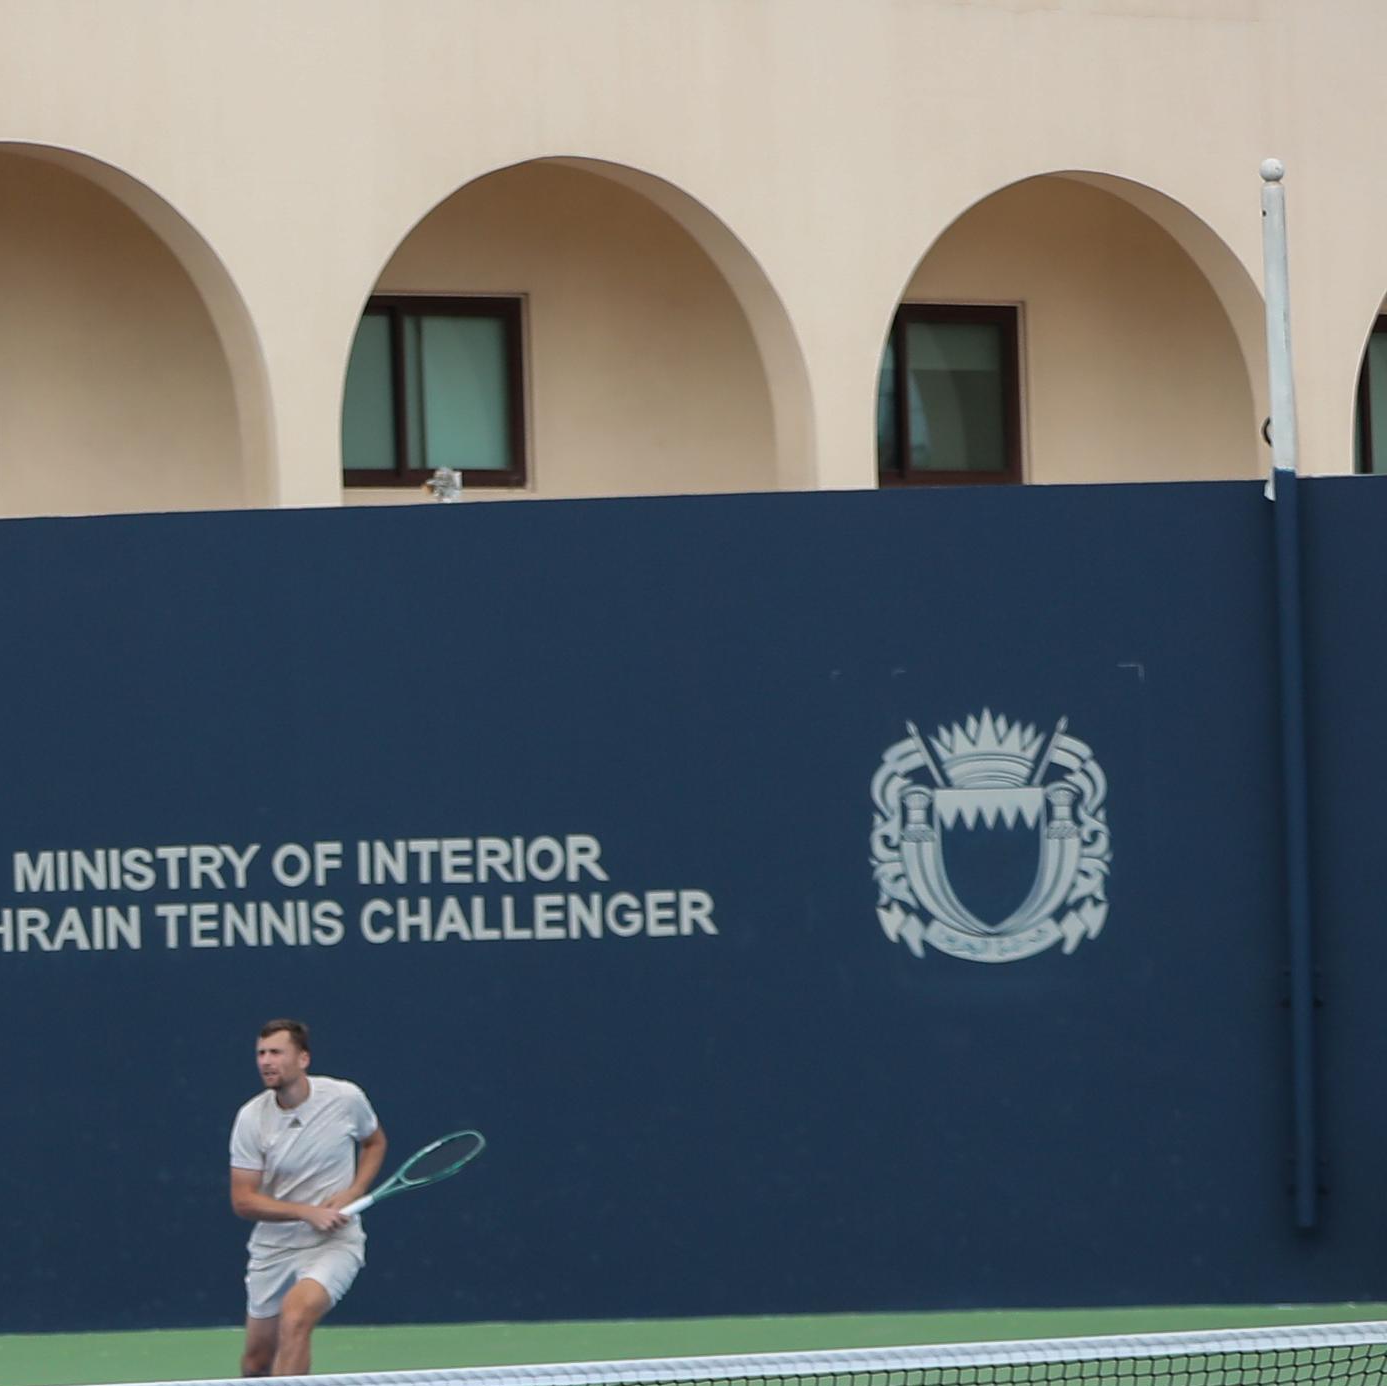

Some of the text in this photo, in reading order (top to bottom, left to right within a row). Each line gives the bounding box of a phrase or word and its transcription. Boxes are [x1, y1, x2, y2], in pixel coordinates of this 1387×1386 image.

[13, 834, 609, 893] MINISTRY OF INTERIOR
[155, 900, 344, 949] TENNIS
[360, 889, 718, 944] CHALLENGER
